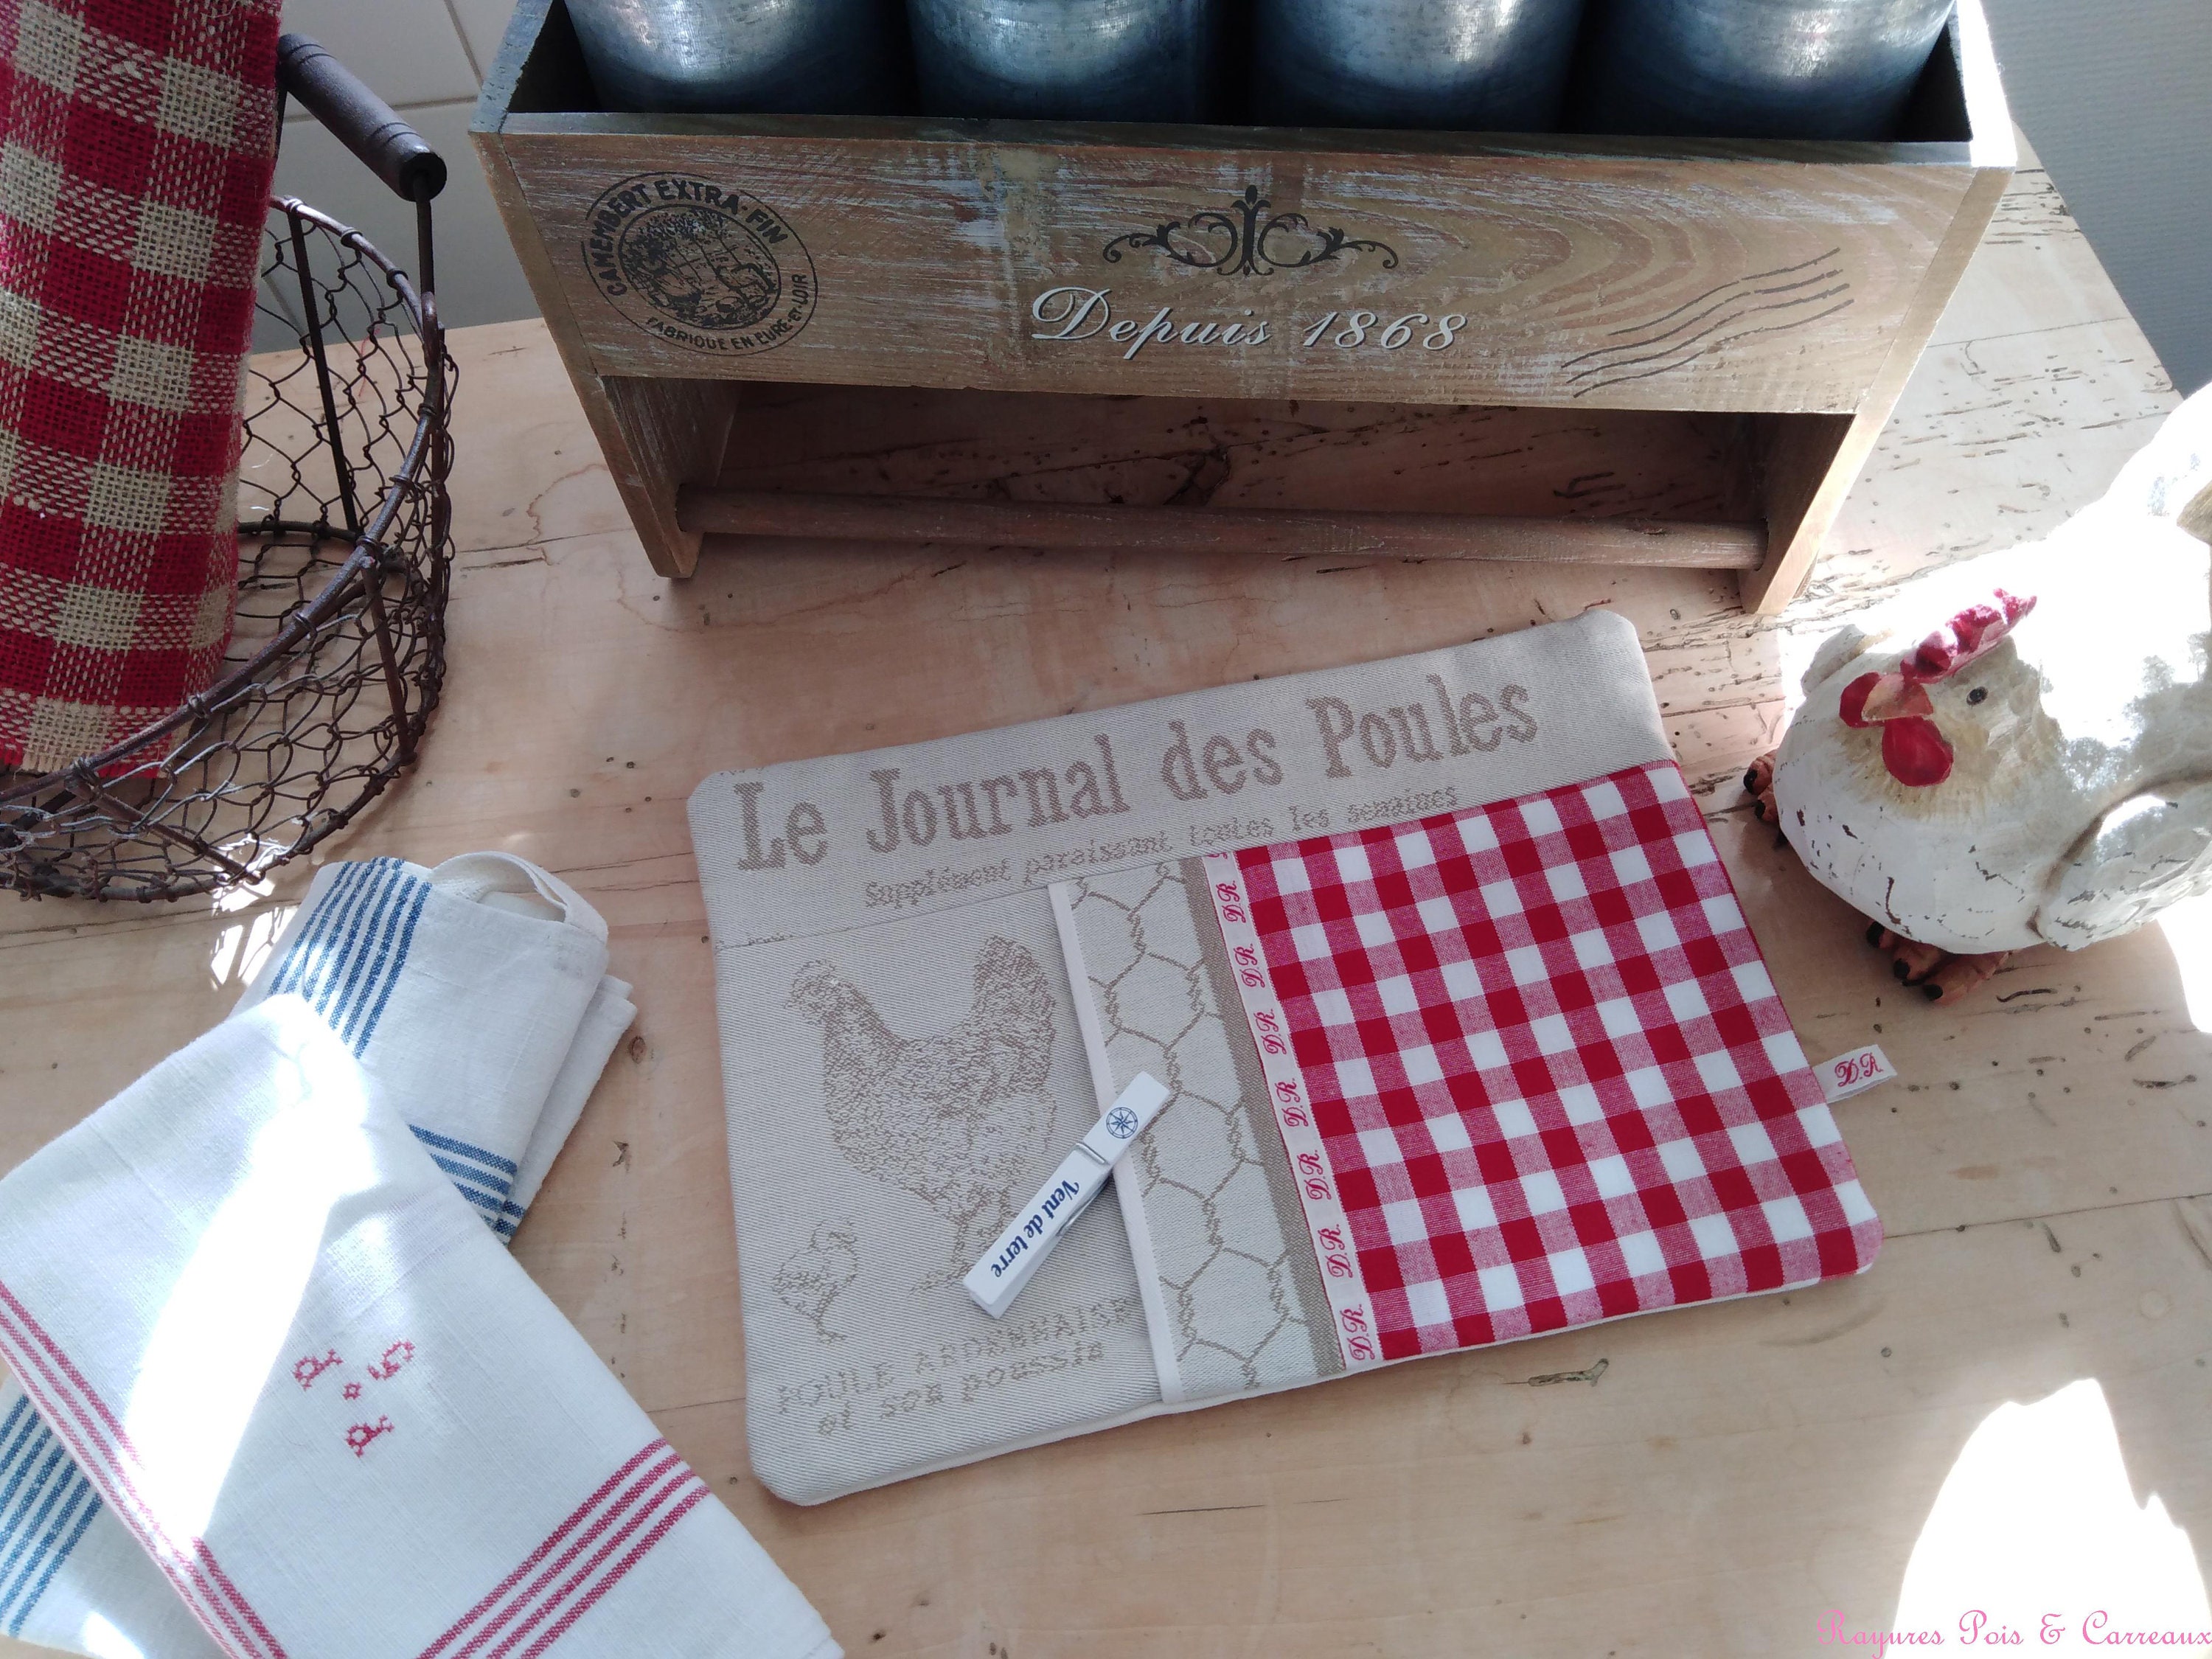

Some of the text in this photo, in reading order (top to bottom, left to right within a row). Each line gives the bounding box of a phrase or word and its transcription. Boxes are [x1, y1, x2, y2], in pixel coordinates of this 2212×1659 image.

[591, 184, 652, 296] CAMEMBERT
[731, 335, 754, 350] EN
[1032, 287, 1468, 361] Depuis 1868
[735, 674, 1538, 871] Le Journal des Poules
[1288, 804, 1330, 832] les
[990, 1180, 1080, 1278] Vent de terre
